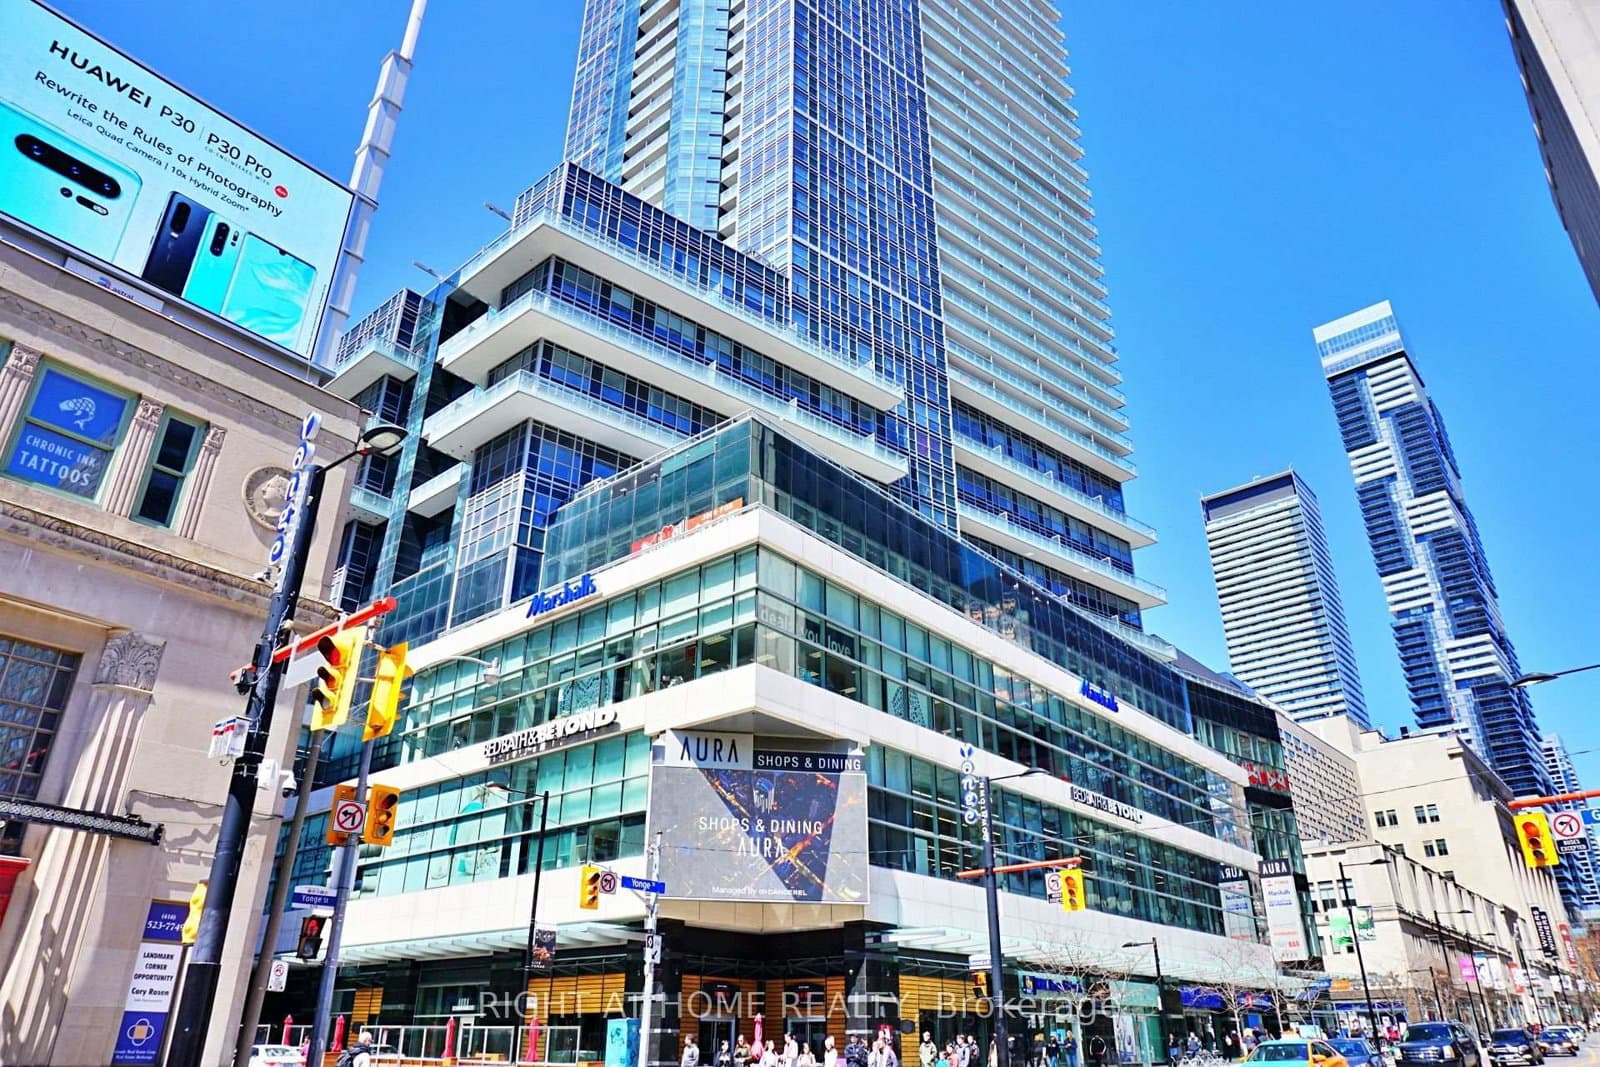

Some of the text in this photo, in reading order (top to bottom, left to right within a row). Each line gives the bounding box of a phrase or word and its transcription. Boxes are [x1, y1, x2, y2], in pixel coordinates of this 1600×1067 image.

[49, 40, 273, 180] HUAWEI P30 P30 Pro
[35, 70, 283, 218] Rewrite the Rules of Photography
[67, 108, 93, 127] Leica
[96, 125, 124, 145] Quad
[126, 141, 163, 166] Camera
[171, 166, 187, 180] 10x
[189, 176, 219, 198] Hybrid
[26, 434, 97, 468] CHRONIC INK
[20, 450, 91, 486] TATTOOS
[526, 573, 598, 618] Marshalls
[827, 634, 852, 657] love
[484, 708, 617, 757] BED BATH & BEYOND
[680, 736, 739, 763] AURA
[757, 754, 862, 771] SHOPS & DINING
[979, 781, 988, 842] DOWNTOWN
[1108, 799, 1144, 824] BEYOND
[699, 816, 824, 835] SHOPS & DINING
[737, 836, 785, 858] AURA
[1262, 862, 1288, 875] AURA
[632, 879, 651, 891] Yonge
[712, 885, 745, 896] Managed
[302, 895, 321, 905] Yonge
[143, 951, 174, 960] LANDMARK
[145, 962, 168, 971] CORNER
[133, 972, 174, 982] OPPORTUNITY
[148, 987, 170, 997] Rosen
